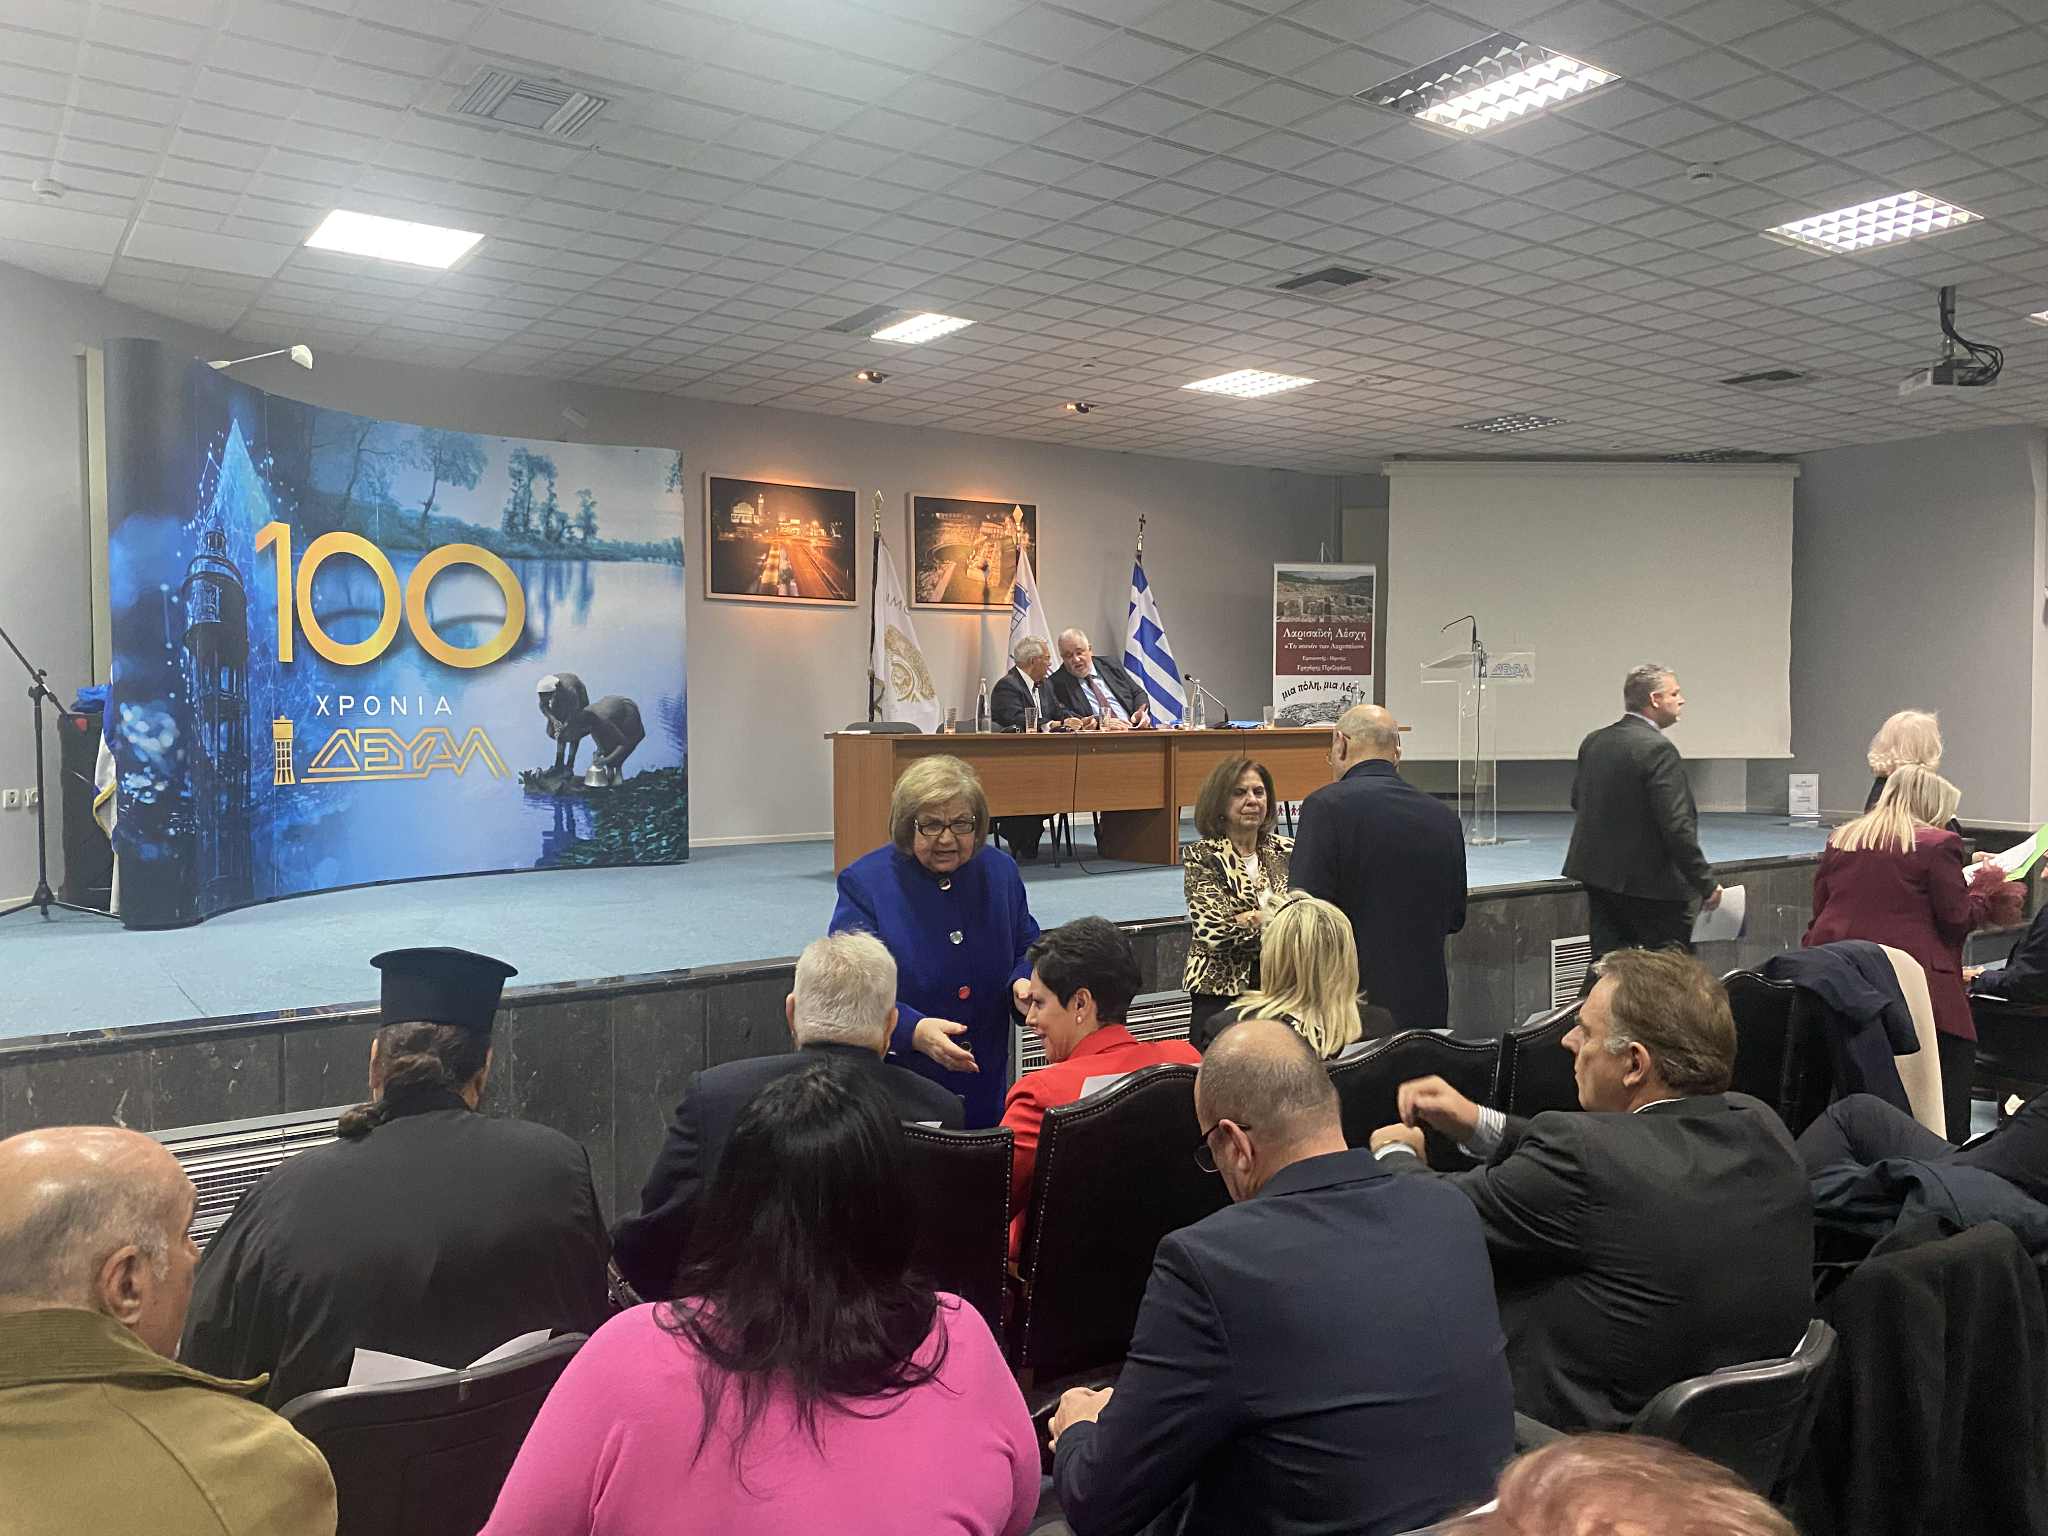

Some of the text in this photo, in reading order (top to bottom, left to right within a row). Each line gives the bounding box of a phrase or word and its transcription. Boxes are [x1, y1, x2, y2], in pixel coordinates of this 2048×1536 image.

[254, 521, 526, 668] 100
[1281, 686, 1297, 701] μια
[1323, 681, 1339, 692] μια
[1339, 682, 1366, 700] λέση
[315, 695, 453, 716] ΧΡΟΝΙΑ
